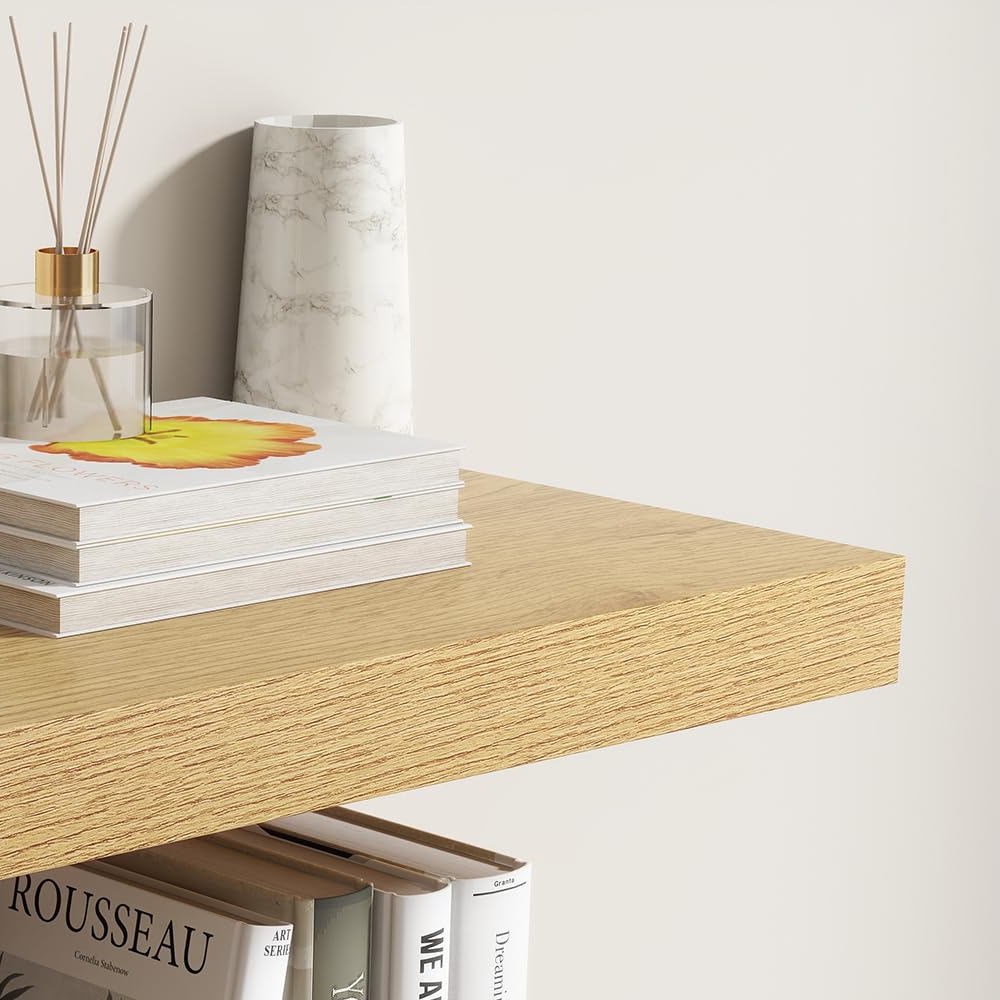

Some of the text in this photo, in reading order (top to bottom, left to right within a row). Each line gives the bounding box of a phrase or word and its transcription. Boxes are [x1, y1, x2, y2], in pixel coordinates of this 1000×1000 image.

[19, 459, 159, 491] FLOWERS
[493, 878, 515, 887] Granta
[8, 874, 214, 974] ROUSSEAU
[272, 928, 291, 942] ART
[74, 950, 100, 966] Cornelia
[419, 927, 445, 974] WE
